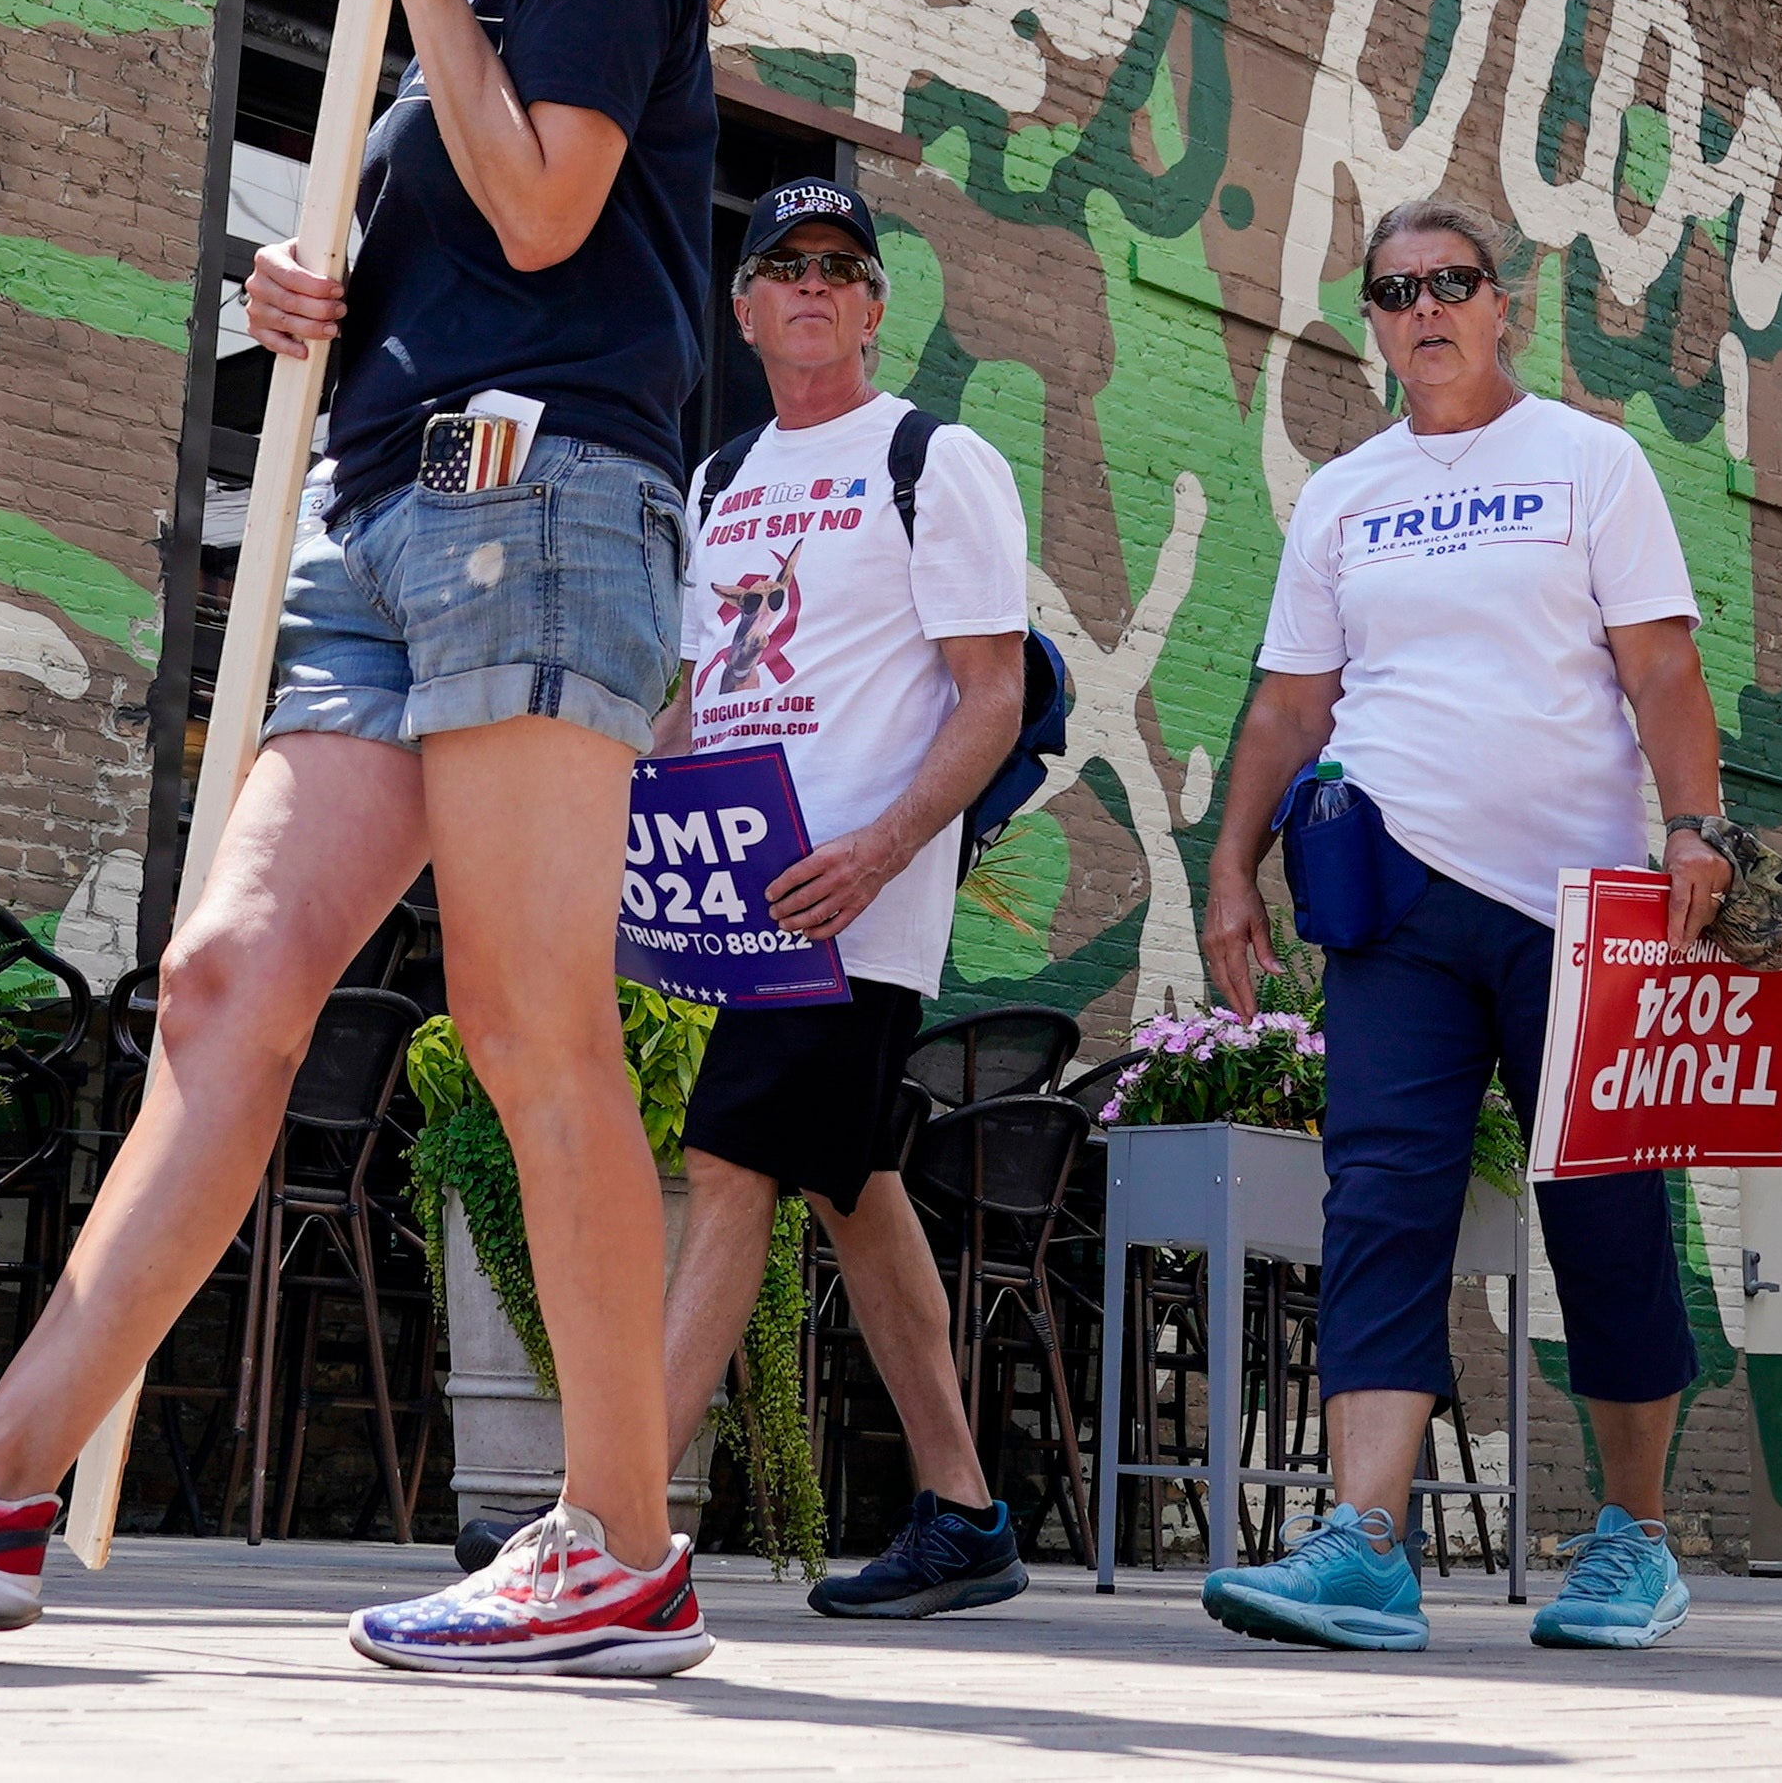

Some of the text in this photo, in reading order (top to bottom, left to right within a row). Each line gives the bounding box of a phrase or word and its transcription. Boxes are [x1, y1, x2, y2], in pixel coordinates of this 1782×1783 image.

[774, 185, 854, 212] Trump
[717, 477, 867, 517] SAVE the USA
[706, 507, 863, 547] JUST SAY NO
[1362, 493, 1544, 545] TRUMP
[1367, 524, 1534, 555] MAKE AMERICA GREAT AGAIN!
[1425, 542, 1468, 557] 2024
[777, 696, 817, 712] JOE
[626, 806, 769, 866] UMP
[620, 869, 748, 924] 024
[620, 921, 814, 956] TRUMP TO 88022
[1602, 937, 1668, 967] 88022
[1686, 938, 1732, 963] UMP
[1633, 973, 1761, 1040] 2024
[1590, 1043, 1778, 1111] TRUMP
